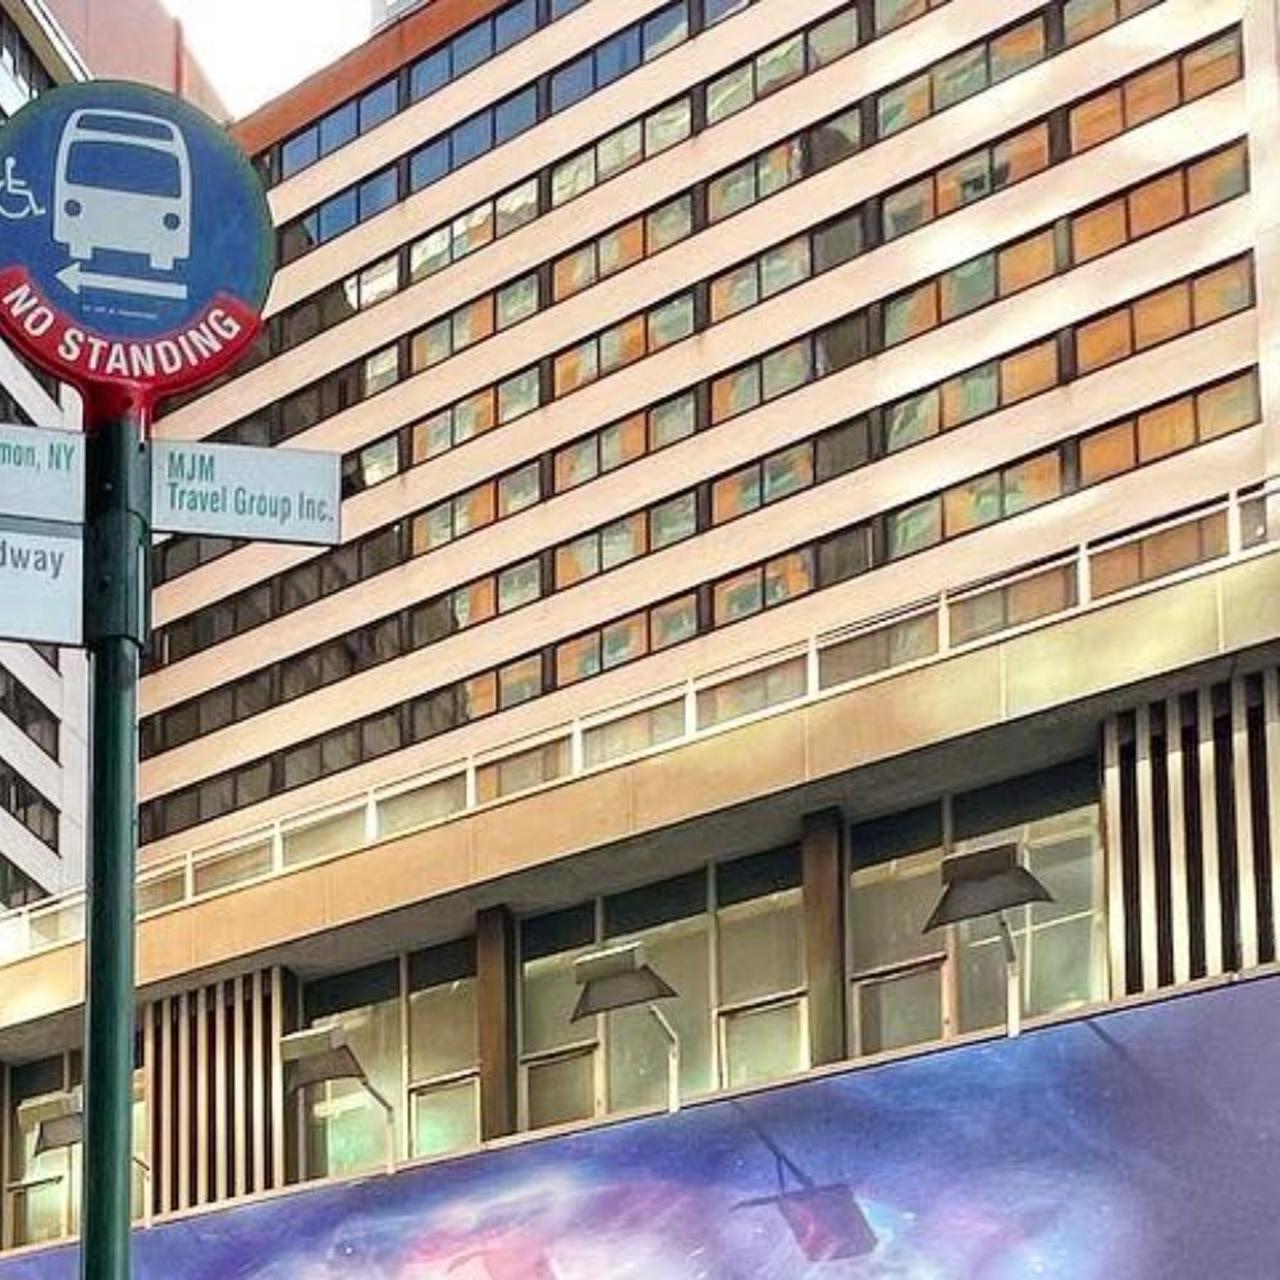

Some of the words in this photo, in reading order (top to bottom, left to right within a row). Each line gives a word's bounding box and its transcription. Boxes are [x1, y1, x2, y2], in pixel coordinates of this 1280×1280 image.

[1, 280, 44, 338] NO
[57, 305, 243, 379] STANDING
[47, 445, 75, 474] NY
[167, 451, 215, 480] MJM
[168, 481, 230, 514] Travel
[233, 487, 292, 522] Group
[298, 492, 335, 523] Inc.
